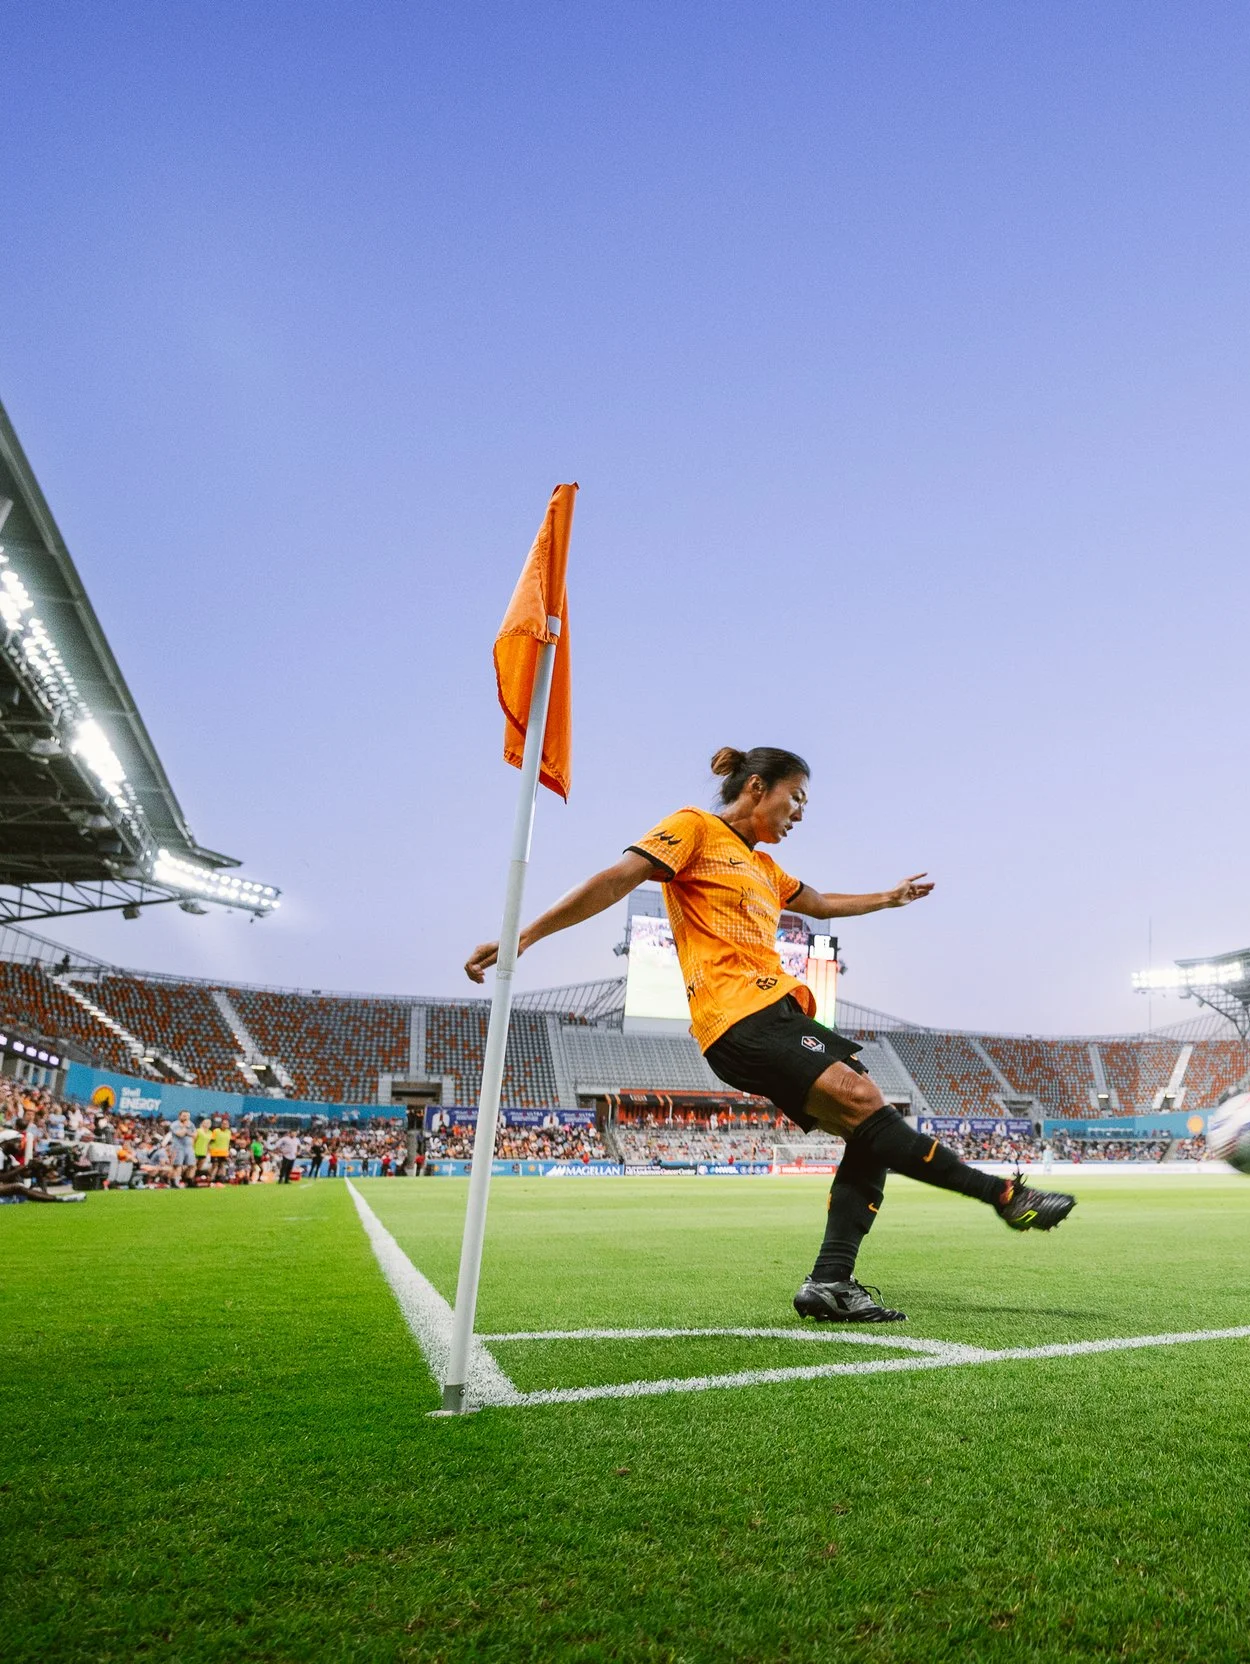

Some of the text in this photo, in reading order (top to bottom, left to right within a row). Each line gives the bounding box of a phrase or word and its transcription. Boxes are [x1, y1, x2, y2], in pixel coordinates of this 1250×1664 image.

[121, 1087, 141, 1096] Shell
[119, 1097, 161, 1111] ENERGY
[566, 1166, 620, 1176] MAGELLAN
